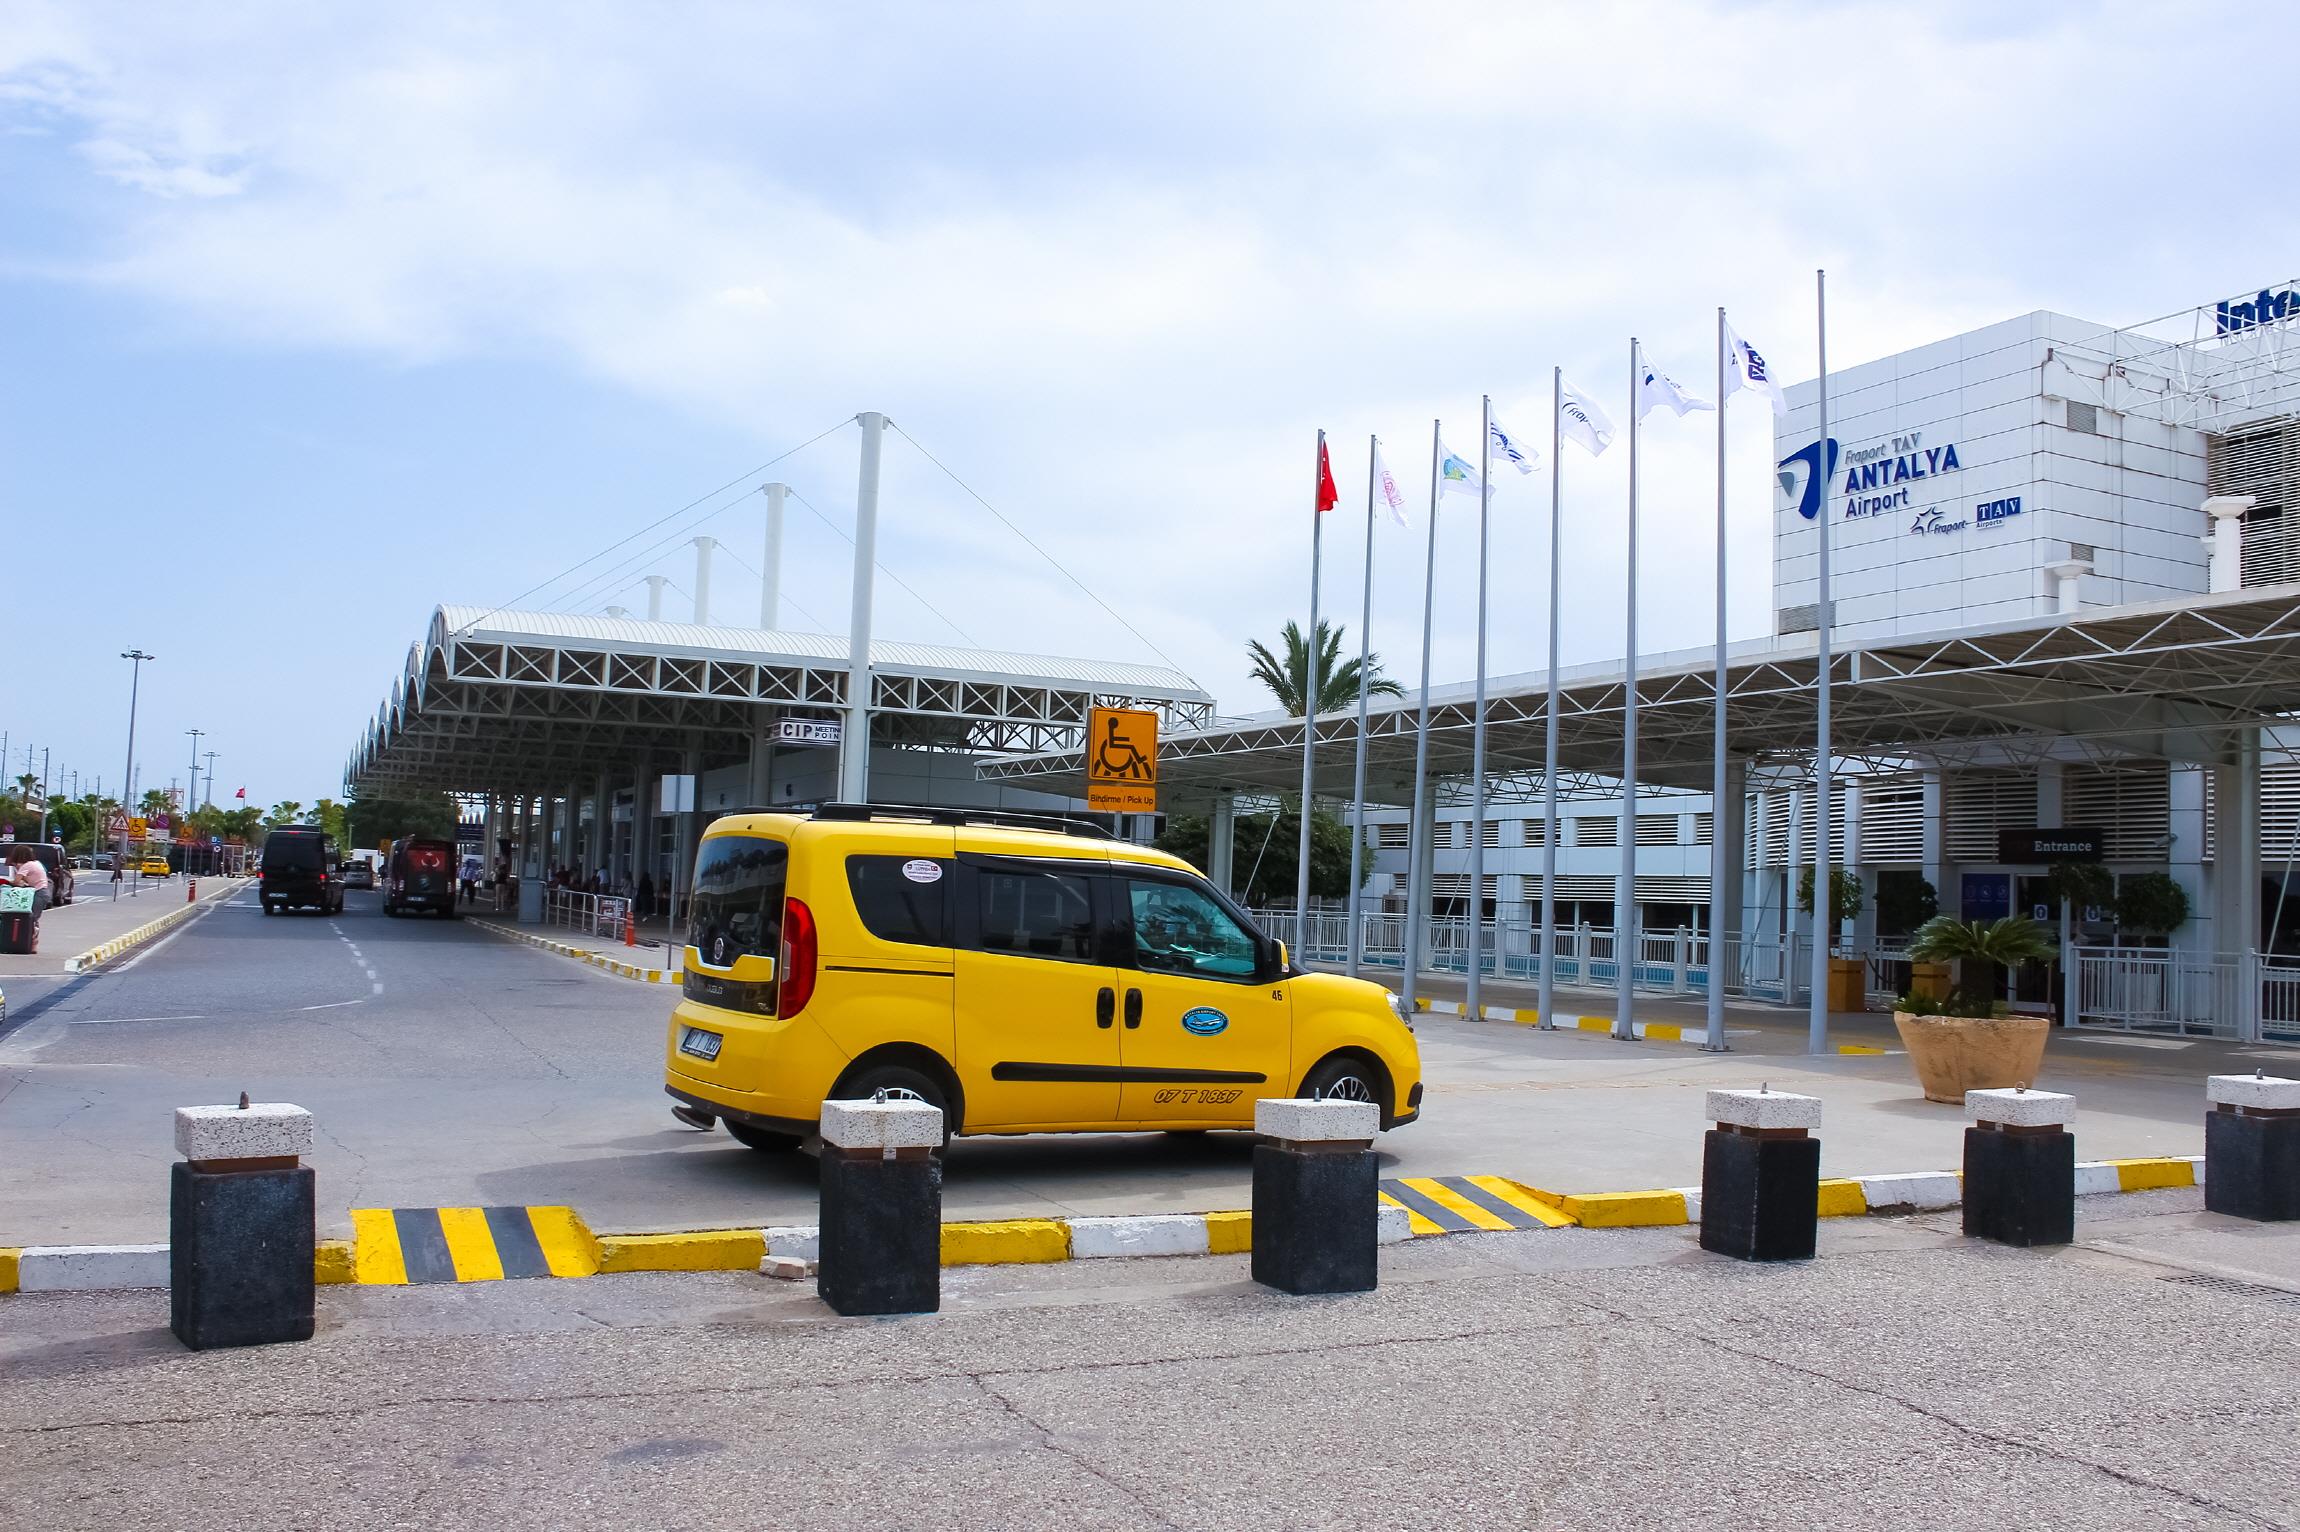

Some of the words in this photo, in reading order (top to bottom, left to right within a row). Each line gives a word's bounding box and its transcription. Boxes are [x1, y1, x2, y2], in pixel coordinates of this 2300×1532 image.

[1844, 443, 1887, 465] Fraport
[1891, 432, 1921, 453] TAV
[1844, 444, 1960, 494] ANTALYA
[1845, 487, 1908, 519] Airport
[1978, 498, 2020, 520] TAV
[1933, 519, 1967, 535] Fraport
[1976, 519, 2003, 529] Airports
[783, 723, 813, 738] CIP
[815, 726, 841, 734] MEETIN
[815, 732, 839, 740] POIN
[1090, 794, 1121, 804] Bindirme
[1127, 795, 1142, 804] Pick
[1144, 796, 1154, 806] Up
[2033, 840, 2093, 852] Entrance
[1272, 990, 1283, 1001] 46
[1153, 1089, 1181, 1104] 07
[1181, 1090, 1198, 1104] T
[1198, 1090, 1244, 1104] 1837
